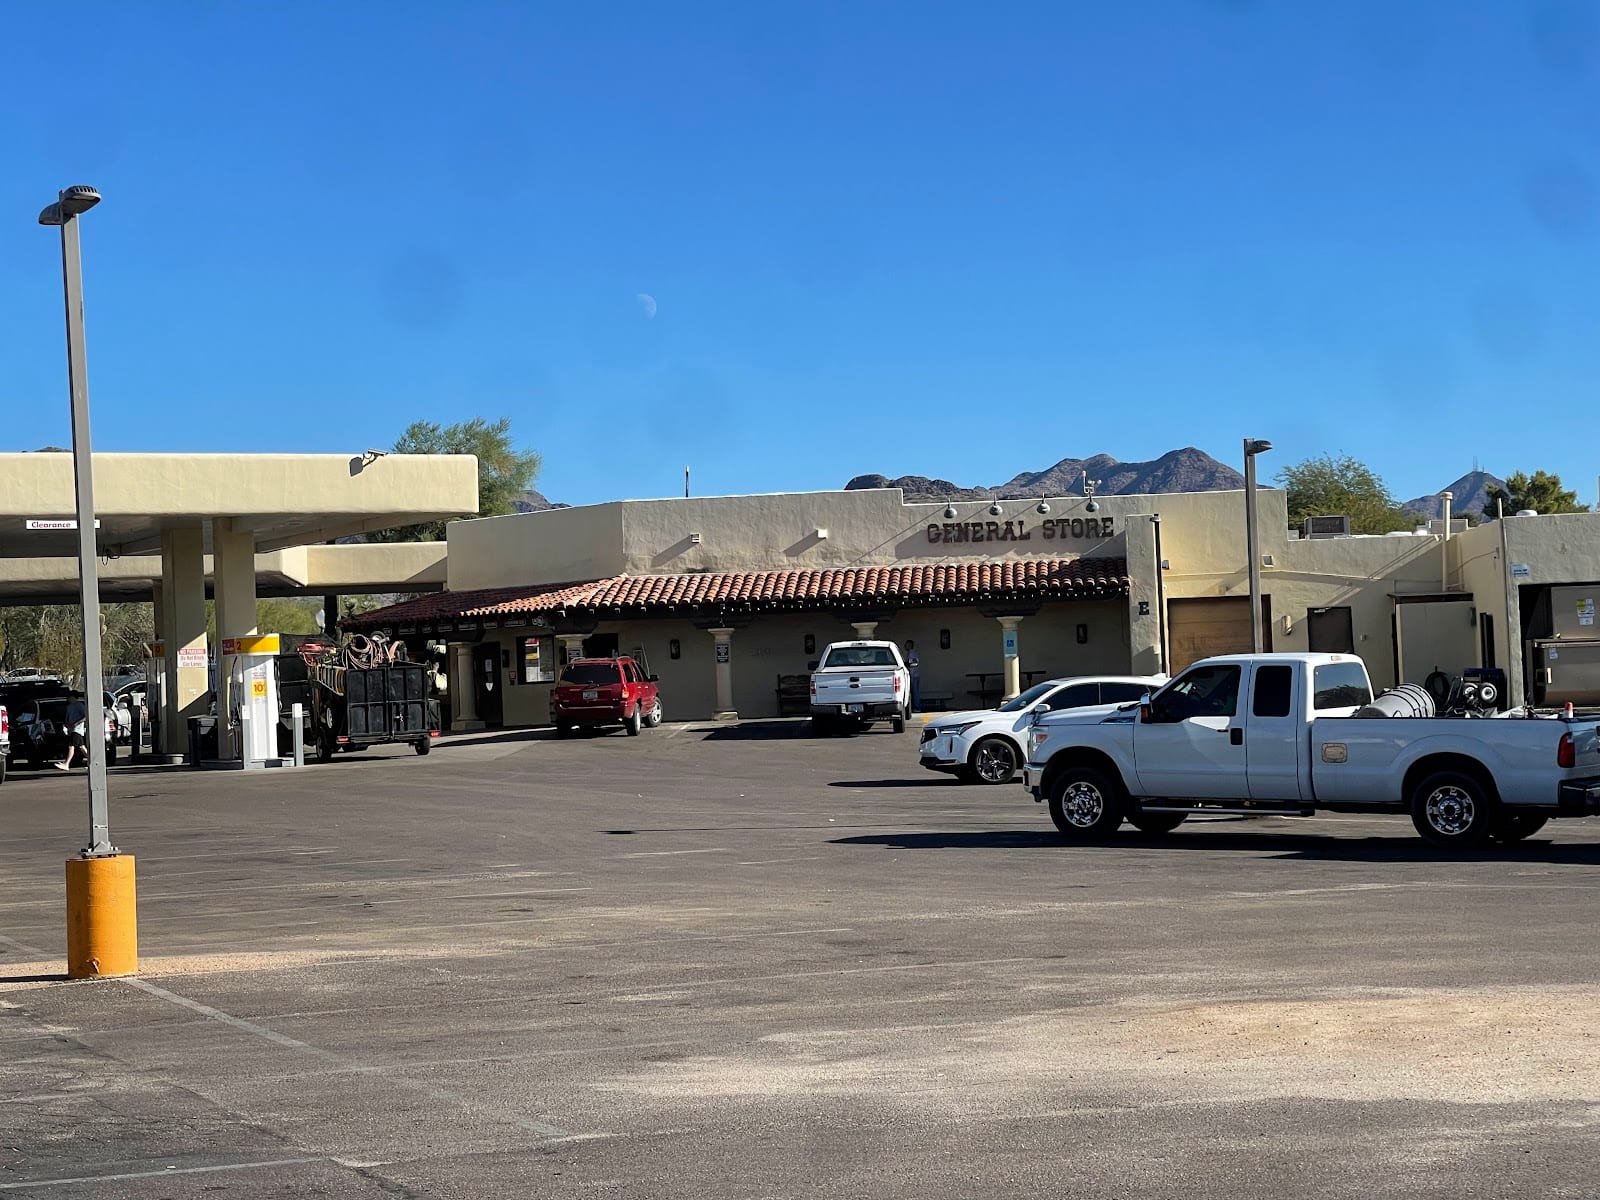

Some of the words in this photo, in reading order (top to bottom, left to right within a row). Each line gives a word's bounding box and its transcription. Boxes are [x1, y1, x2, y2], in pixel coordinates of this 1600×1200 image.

[928, 521, 1030, 543] GENERAL
[1043, 517, 1113, 539] STORE
[1138, 601, 1150, 615] E
[253, 683, 264, 692] 10
